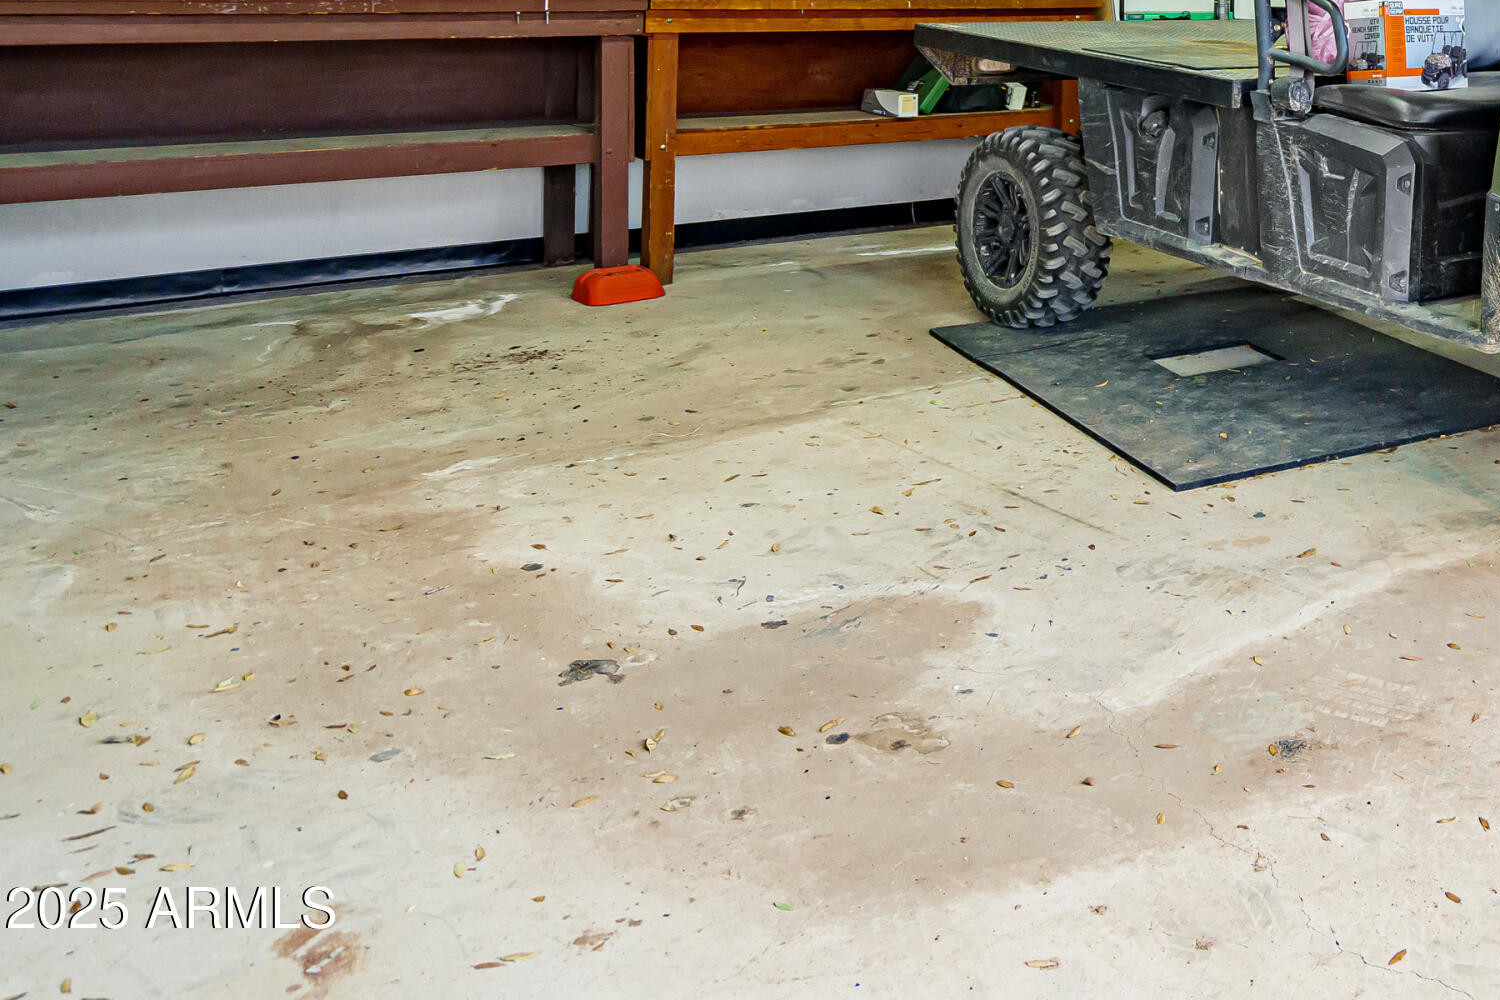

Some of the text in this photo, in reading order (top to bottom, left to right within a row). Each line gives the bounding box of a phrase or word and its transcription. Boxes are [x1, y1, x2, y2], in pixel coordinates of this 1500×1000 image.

[1405, 16, 1449, 25] HOUSSE POUR
[1405, 25, 1444, 34] BANQUETTE
[1406, 34, 1415, 43] DE
